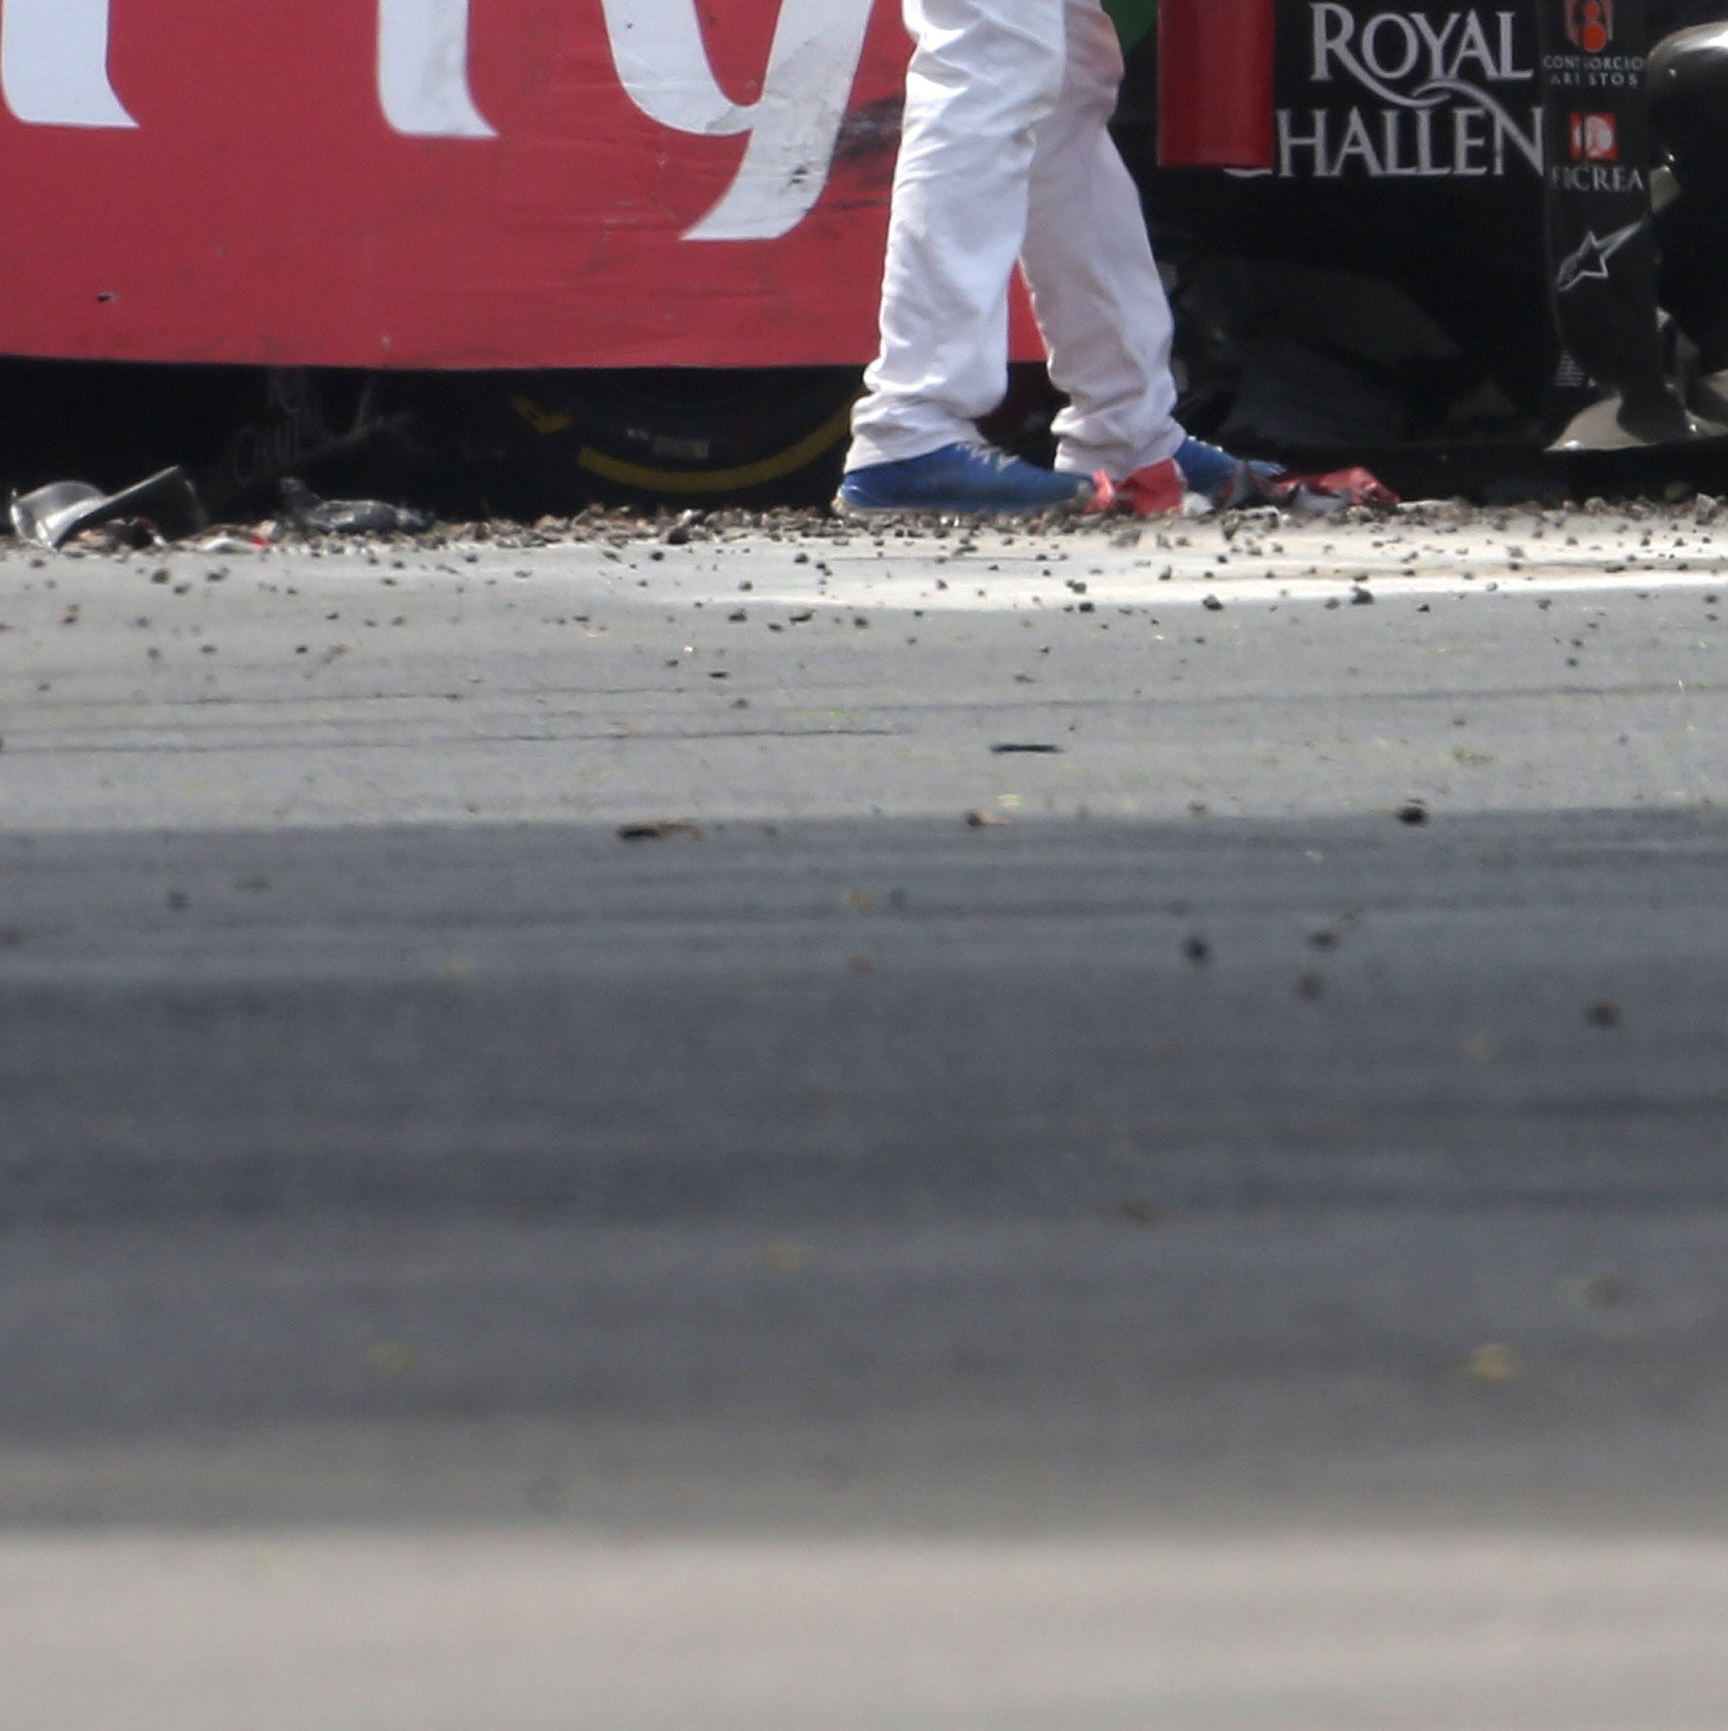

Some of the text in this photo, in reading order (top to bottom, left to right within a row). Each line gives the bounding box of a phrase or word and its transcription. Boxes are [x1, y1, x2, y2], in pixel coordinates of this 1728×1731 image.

[1308, 2, 1534, 107] ROYAL
[1543, 55, 1645, 71] CONORCIO
[1223, 105, 1545, 178] HALLEN
